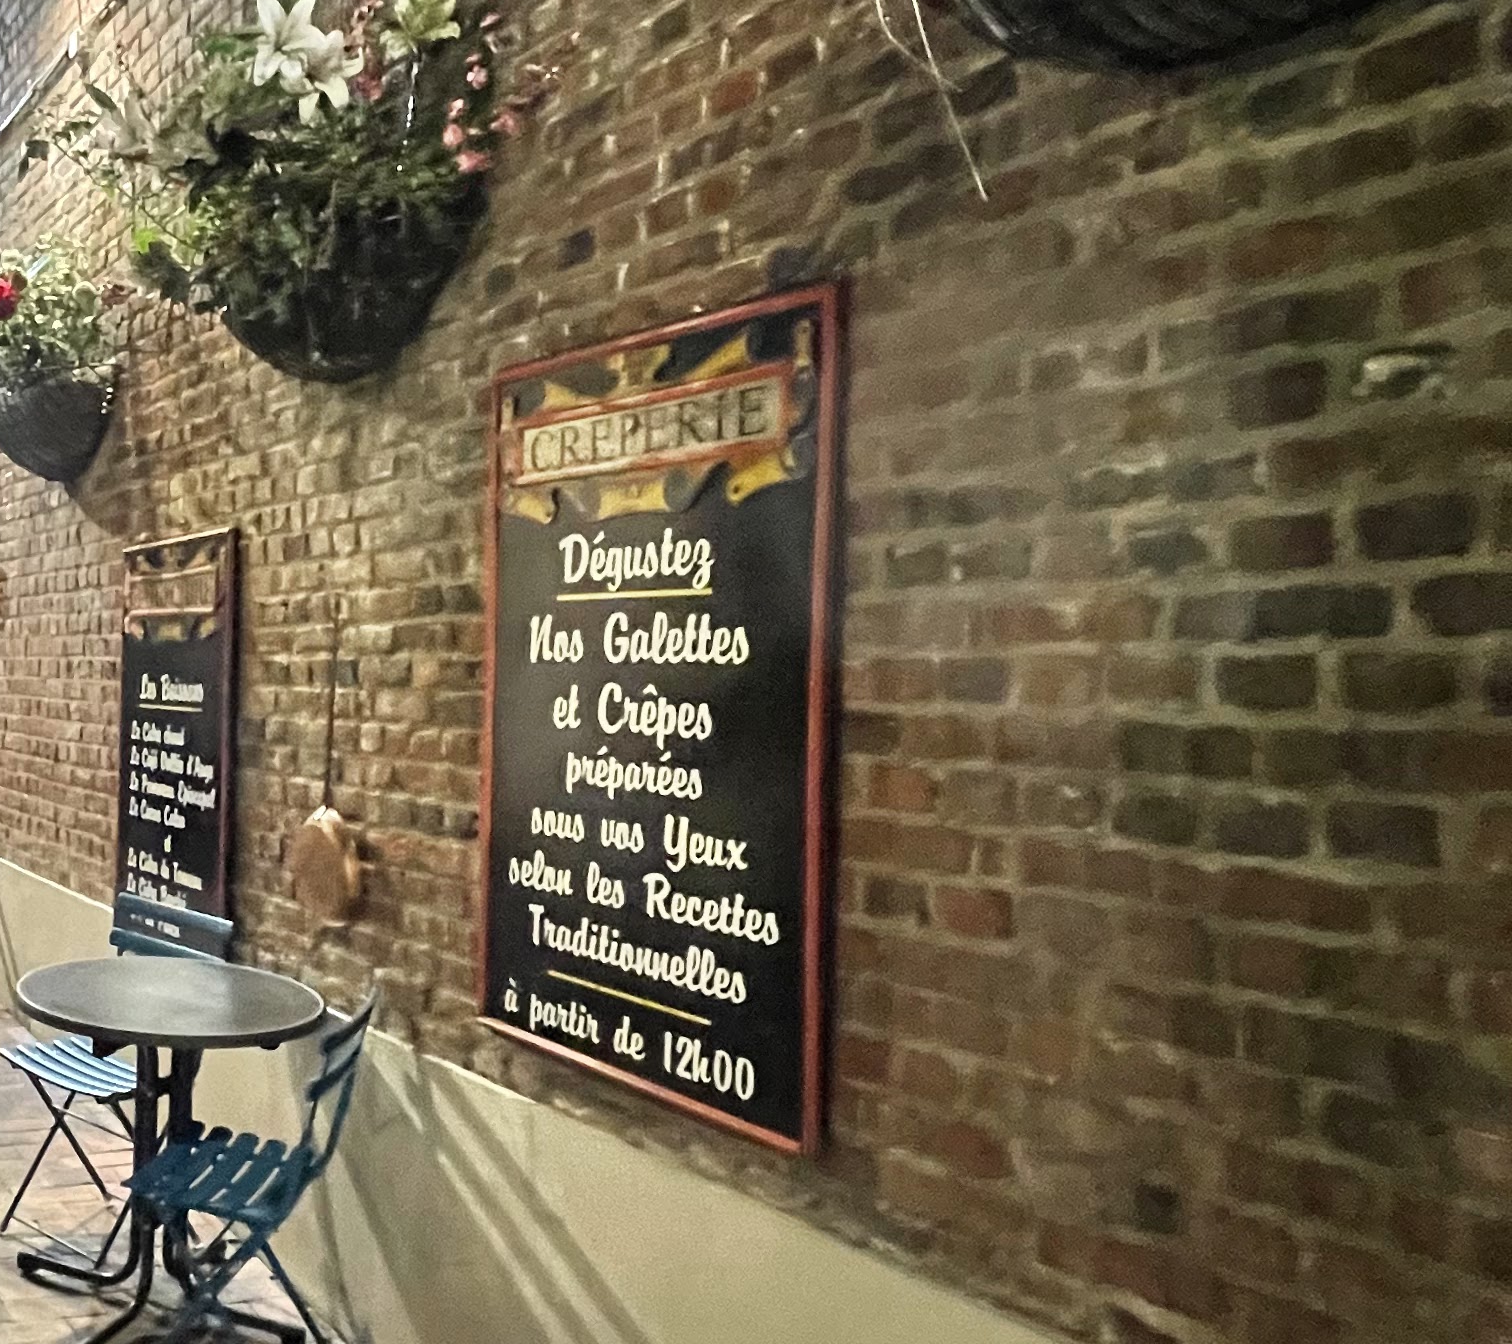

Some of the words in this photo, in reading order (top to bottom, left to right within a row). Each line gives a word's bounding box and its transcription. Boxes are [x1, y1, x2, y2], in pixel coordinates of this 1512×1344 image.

[530, 384, 768, 473] CREPERIE
[558, 527, 715, 589] Dégustez
[529, 613, 585, 664] Nos
[603, 611, 750, 665] Galettes
[552, 683, 582, 730] et
[597, 681, 713, 751] Crêpes
[565, 745, 703, 801] préparées
[530, 806, 585, 843] sous
[600, 817, 645, 854] vos
[663, 813, 748, 873] Yeux
[508, 849, 574, 896] selon
[586, 861, 625, 909] les
[642, 872, 779, 946] Recettes
[528, 903, 747, 1004] Traditionnelles
[504, 977, 519, 1013] à
[529, 1000, 600, 1044] partir
[613, 1015, 646, 1061] de
[663, 1031, 755, 1101] 12h00
